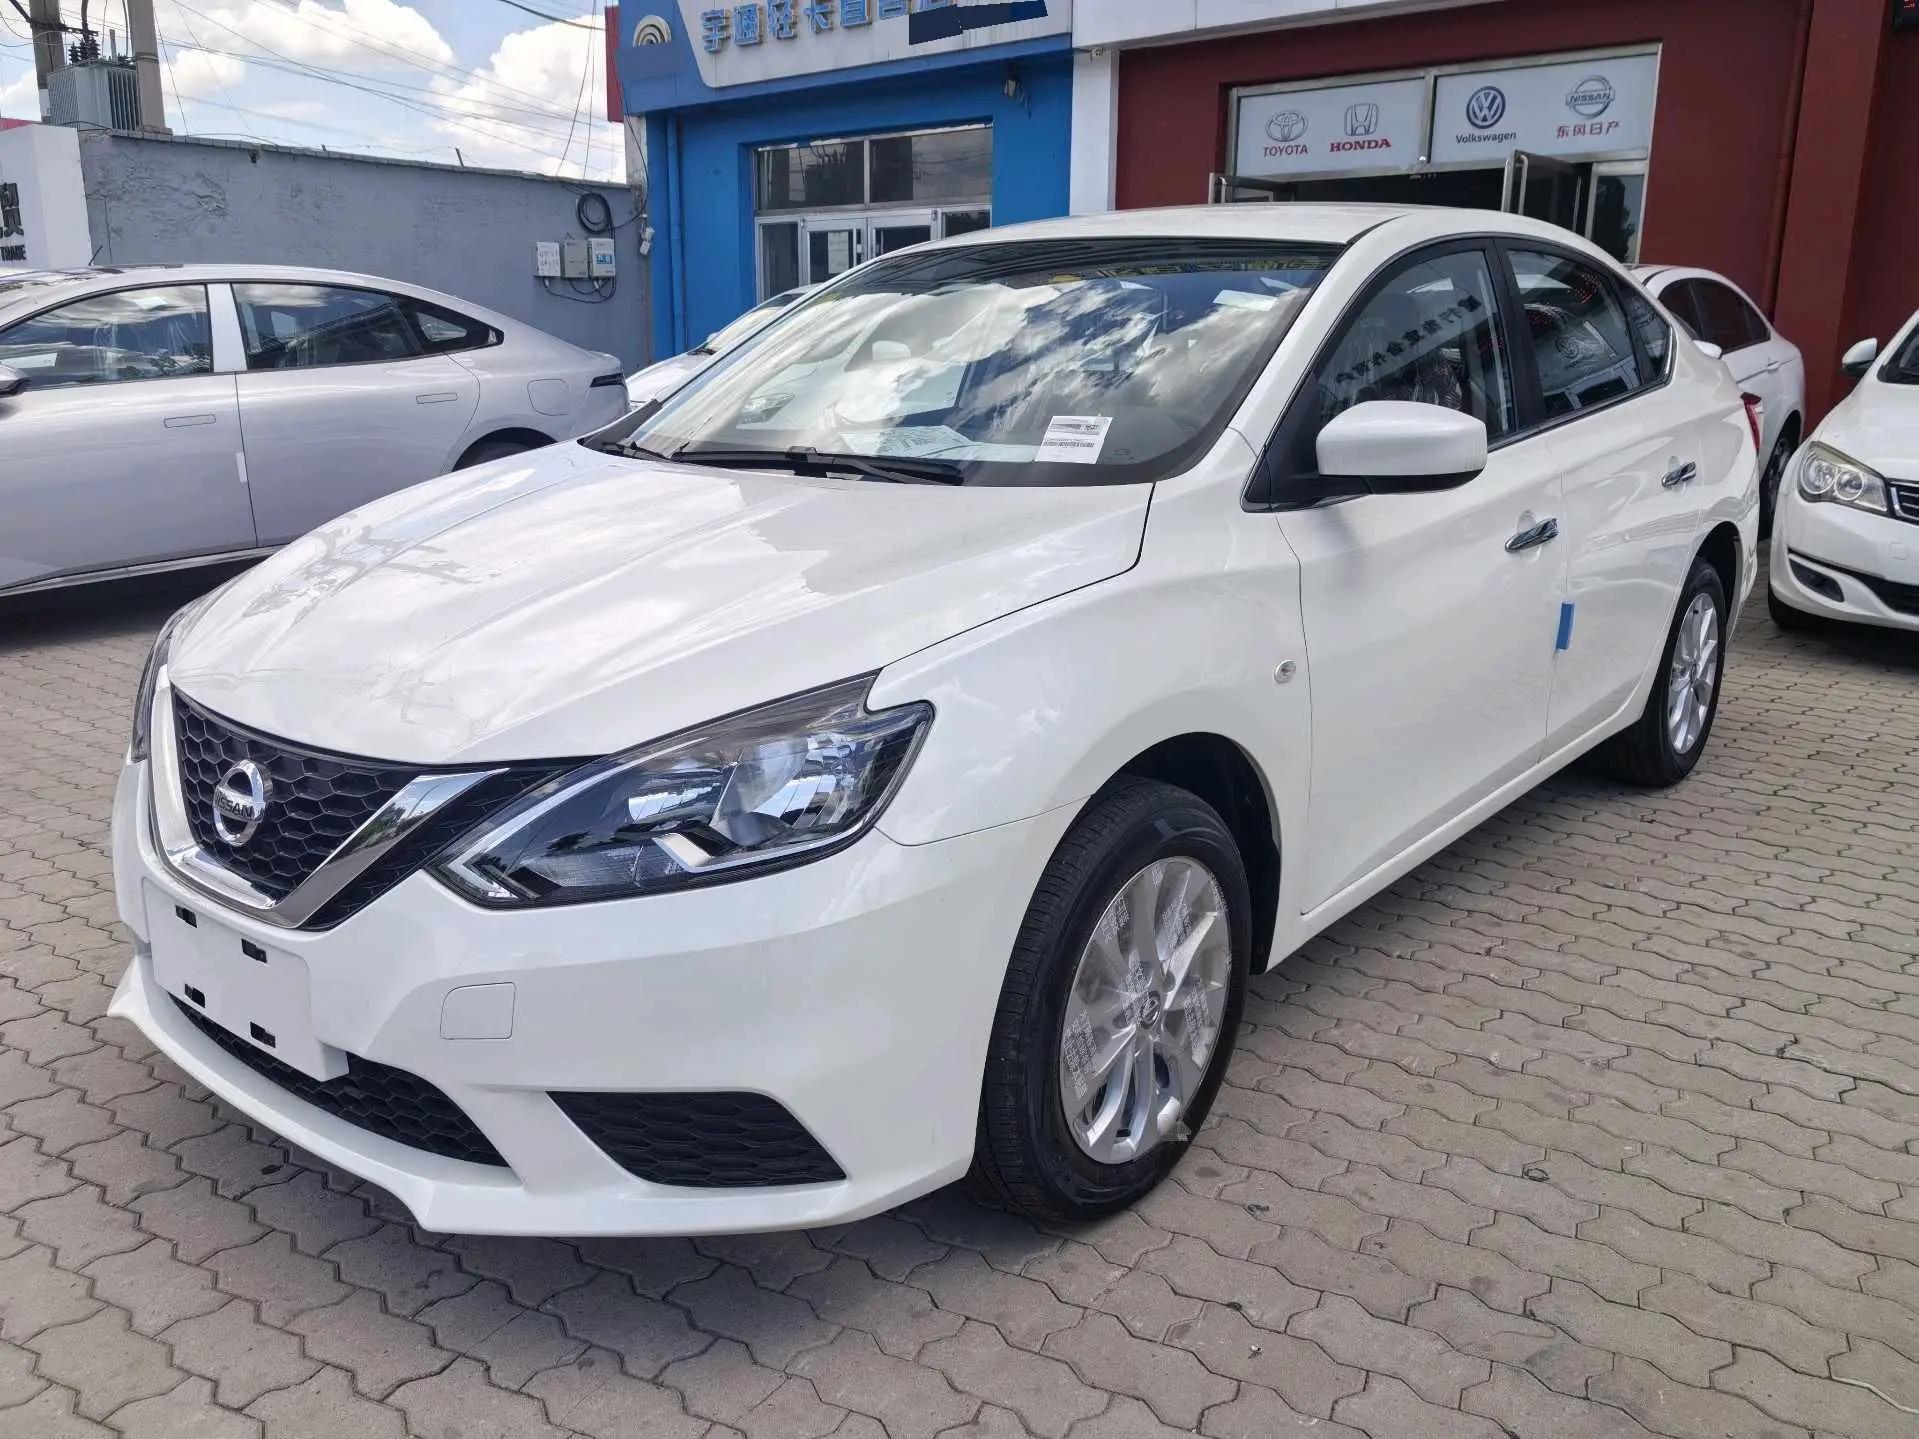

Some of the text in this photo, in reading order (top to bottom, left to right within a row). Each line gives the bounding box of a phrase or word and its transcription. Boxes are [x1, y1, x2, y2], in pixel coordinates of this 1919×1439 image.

[1569, 92, 1611, 105] NISSAN
[1556, 120, 1620, 139] 东风日产
[1455, 131, 1517, 144] Volkswagen
[1263, 144, 1309, 157] TOYOTA
[1329, 138, 1392, 153] HONDA
[215, 788, 255, 819] NISSAN
